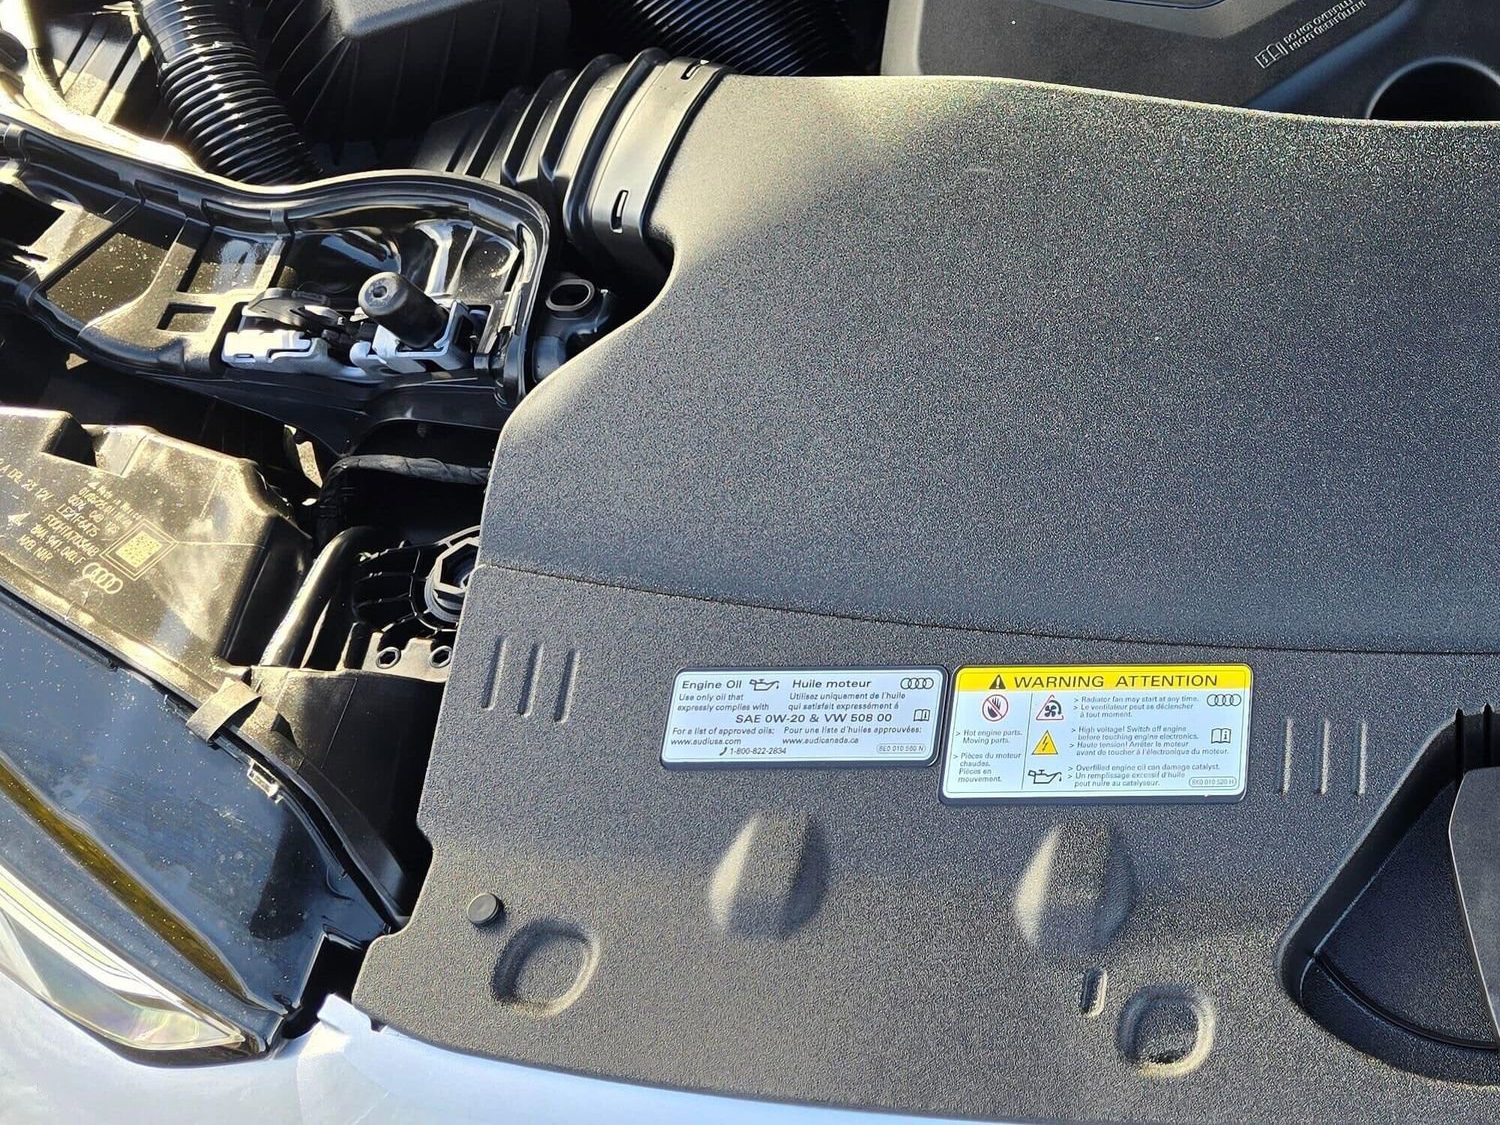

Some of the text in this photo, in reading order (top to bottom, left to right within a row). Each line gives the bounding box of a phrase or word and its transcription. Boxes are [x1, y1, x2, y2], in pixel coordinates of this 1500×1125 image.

[1283, 33, 1297, 44] DO
[1296, 22, 1314, 37] NOT
[682, 679, 742, 691] Engine Oil
[792, 679, 872, 689] Huile moteur
[1014, 675, 1218, 688] WARNING ATTENTION
[679, 693, 744, 702] Use only oil that
[820, 693, 868, 701] uniquement
[1124, 696, 1140, 704] may
[1141, 695, 1158, 703] start
[677, 703, 770, 713] expressly complies with
[788, 703, 801, 711] qui
[836, 702, 892, 711] expressément
[1080, 703, 1090, 711] Le
[1091, 703, 1128, 711] ventilateur
[1129, 703, 1145, 711] peut
[735, 713, 892, 723] SAE 0W-20 & VW 508 00
[672, 727, 686, 735] For
[694, 727, 706, 735] list
[708, 727, 718, 735] of
[718, 727, 756, 736] approved
[758, 727, 775, 735] oils:
[822, 726, 838, 734] liste
[840, 726, 872, 734] d'huiles
[1002, 729, 1023, 737] parts.
[1078, 725, 1187, 734] High voltage! Switch off engine
[962, 737, 1010, 745] Moving parts.
[1102, 734, 1132, 742] touching
[1076, 741, 1098, 749] Haute
[729, 747, 787, 755] 1-800-822-2834
[1111, 764, 1136, 773] engine
[1161, 763, 1190, 772] damage
[1191, 763, 1220, 771] catalyst.
[1075, 771, 1086, 779] Un
[1087, 771, 1130, 781] remplissage
[1074, 780, 1091, 788] peut
[1092, 779, 1110, 787] nuire
[1122, 779, 1160, 788] catalyseur.
